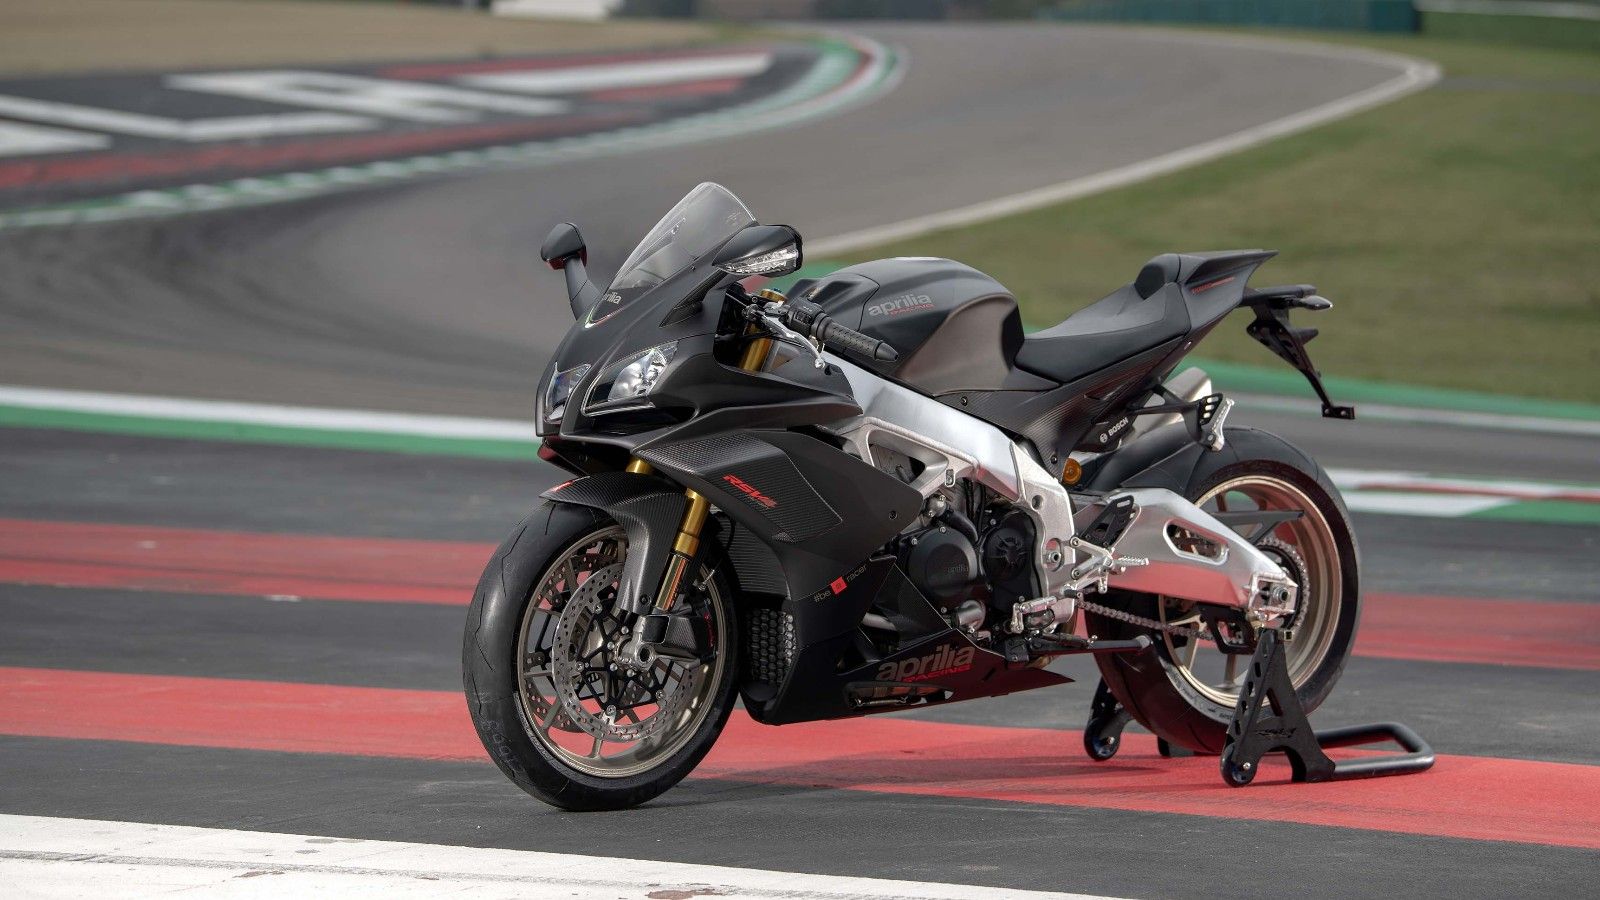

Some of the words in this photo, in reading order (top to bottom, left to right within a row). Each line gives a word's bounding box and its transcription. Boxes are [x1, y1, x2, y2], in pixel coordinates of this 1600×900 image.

[868, 293, 932, 316] aprilia
[1108, 417, 1129, 436] BOSCH
[846, 564, 867, 582] racer
[875, 643, 976, 682] aprilia
